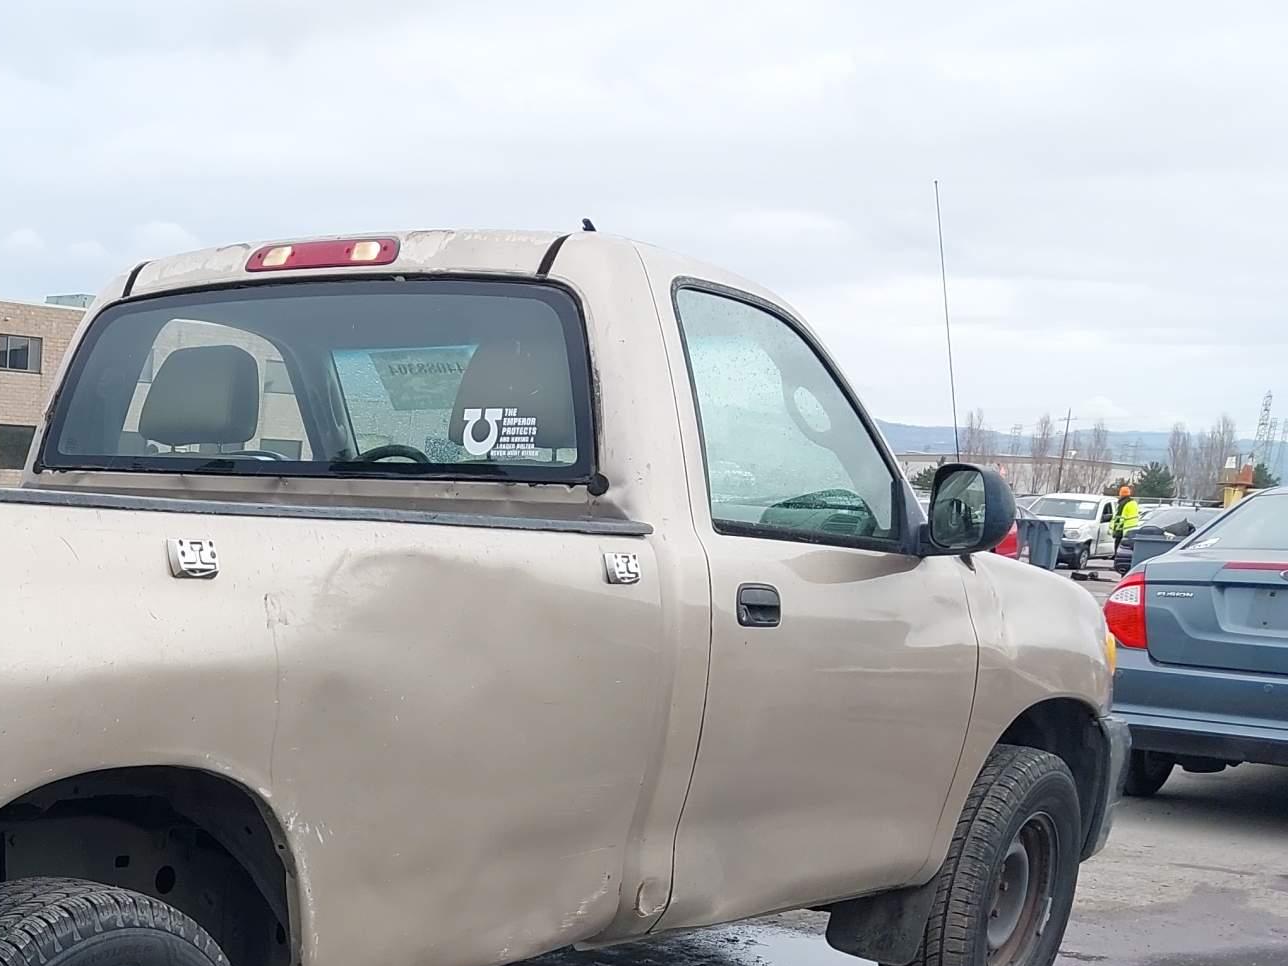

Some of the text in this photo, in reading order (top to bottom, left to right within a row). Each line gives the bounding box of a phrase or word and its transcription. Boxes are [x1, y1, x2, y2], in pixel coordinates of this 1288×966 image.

[505, 408, 518, 416] THE
[503, 417, 537, 426] EMPEROR
[501, 427, 537, 435] PROTECTS
